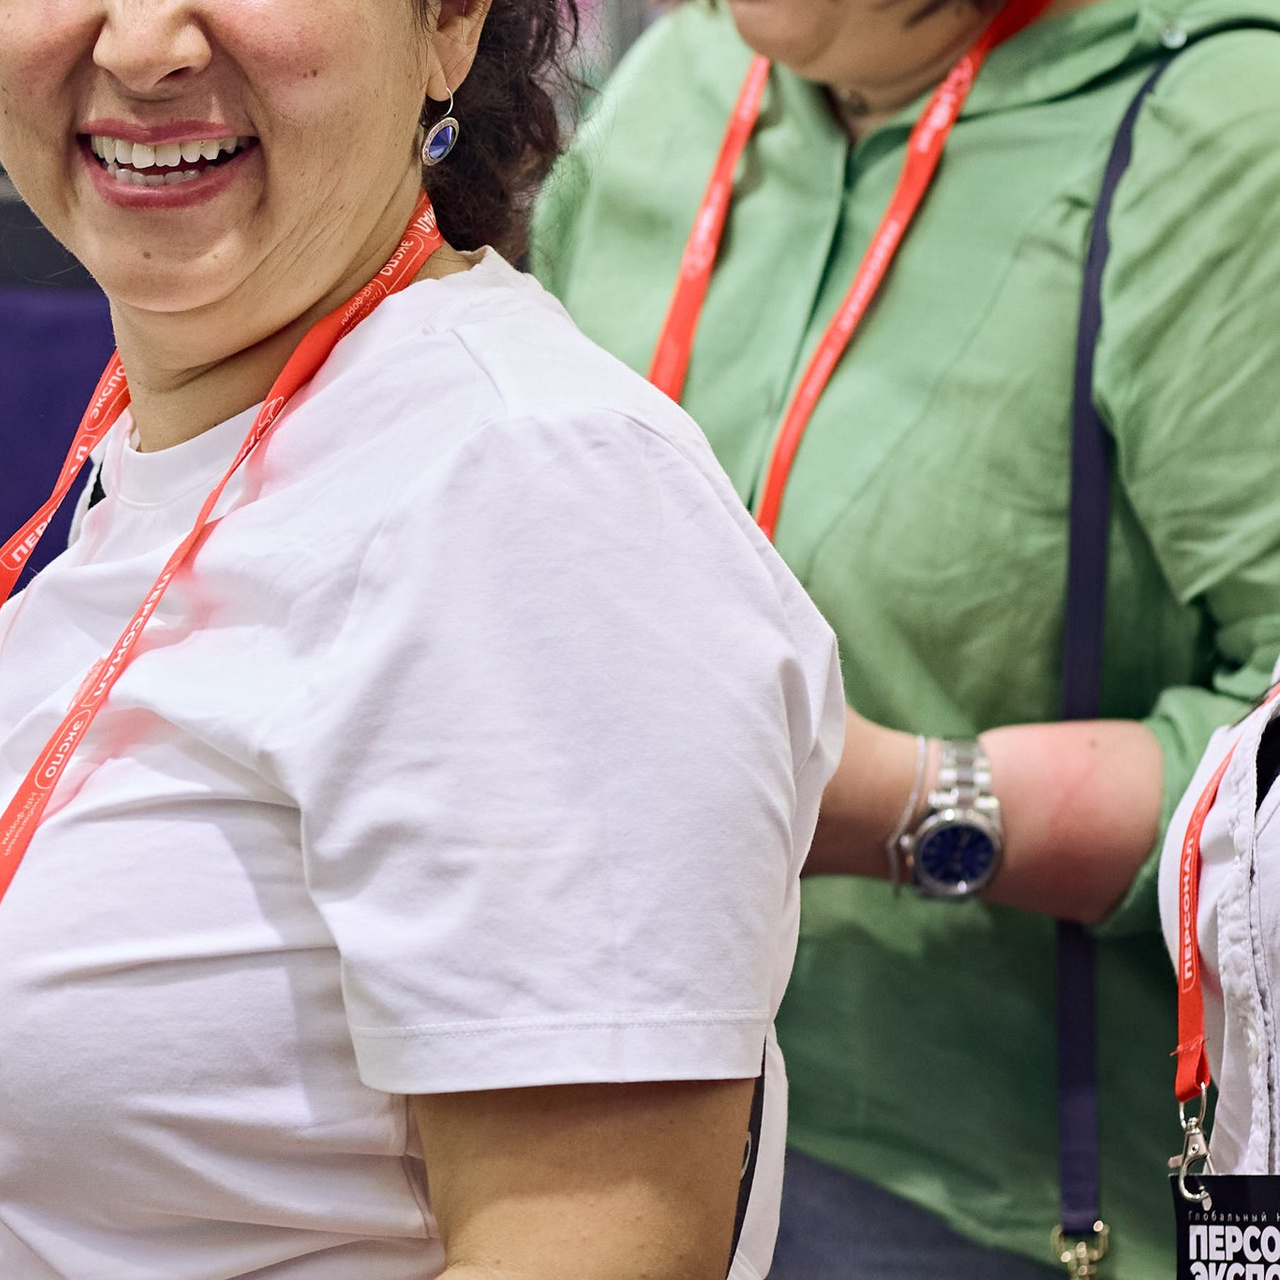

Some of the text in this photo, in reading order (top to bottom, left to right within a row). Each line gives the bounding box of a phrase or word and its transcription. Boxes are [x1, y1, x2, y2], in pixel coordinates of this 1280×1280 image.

[93, 572, 171, 697] ПЕРСОНАЛ
[45, 720, 84, 778] ЭКСПО
[1182, 837, 1195, 980] ПЕРСОНАЛ
[1188, 1210, 1267, 1223] Глобальный
[1188, 1224, 1280, 1263] ПЕРСО
